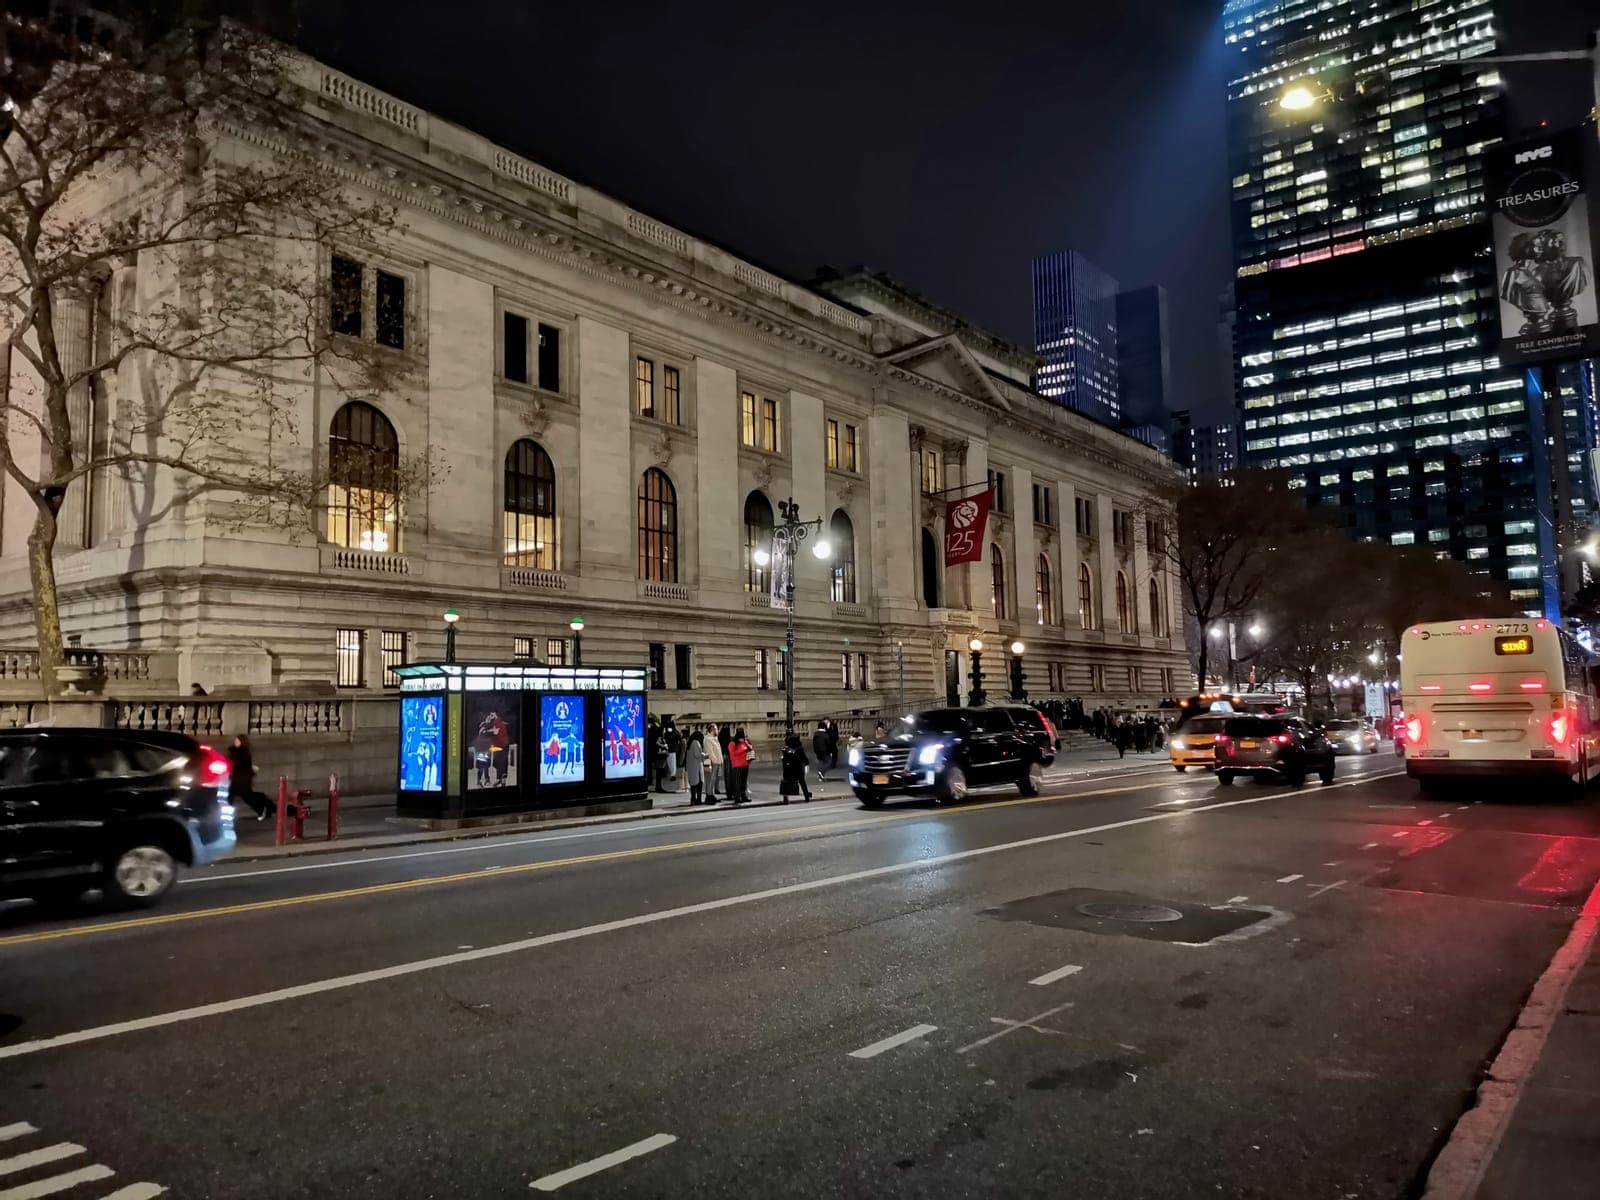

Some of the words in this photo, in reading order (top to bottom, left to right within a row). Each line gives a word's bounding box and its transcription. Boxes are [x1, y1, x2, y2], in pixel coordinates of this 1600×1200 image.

[1515, 146, 1552, 164] NYC
[1496, 181, 1580, 208] TREASURES
[1515, 341, 1535, 350] FREE
[1537, 333, 1587, 346] EXHIBITION
[946, 530, 975, 556] 125
[1496, 623, 1529, 634] 2773
[500, 682, 536, 690] BRYNT
[575, 683, 621, 691] EWSTAND
